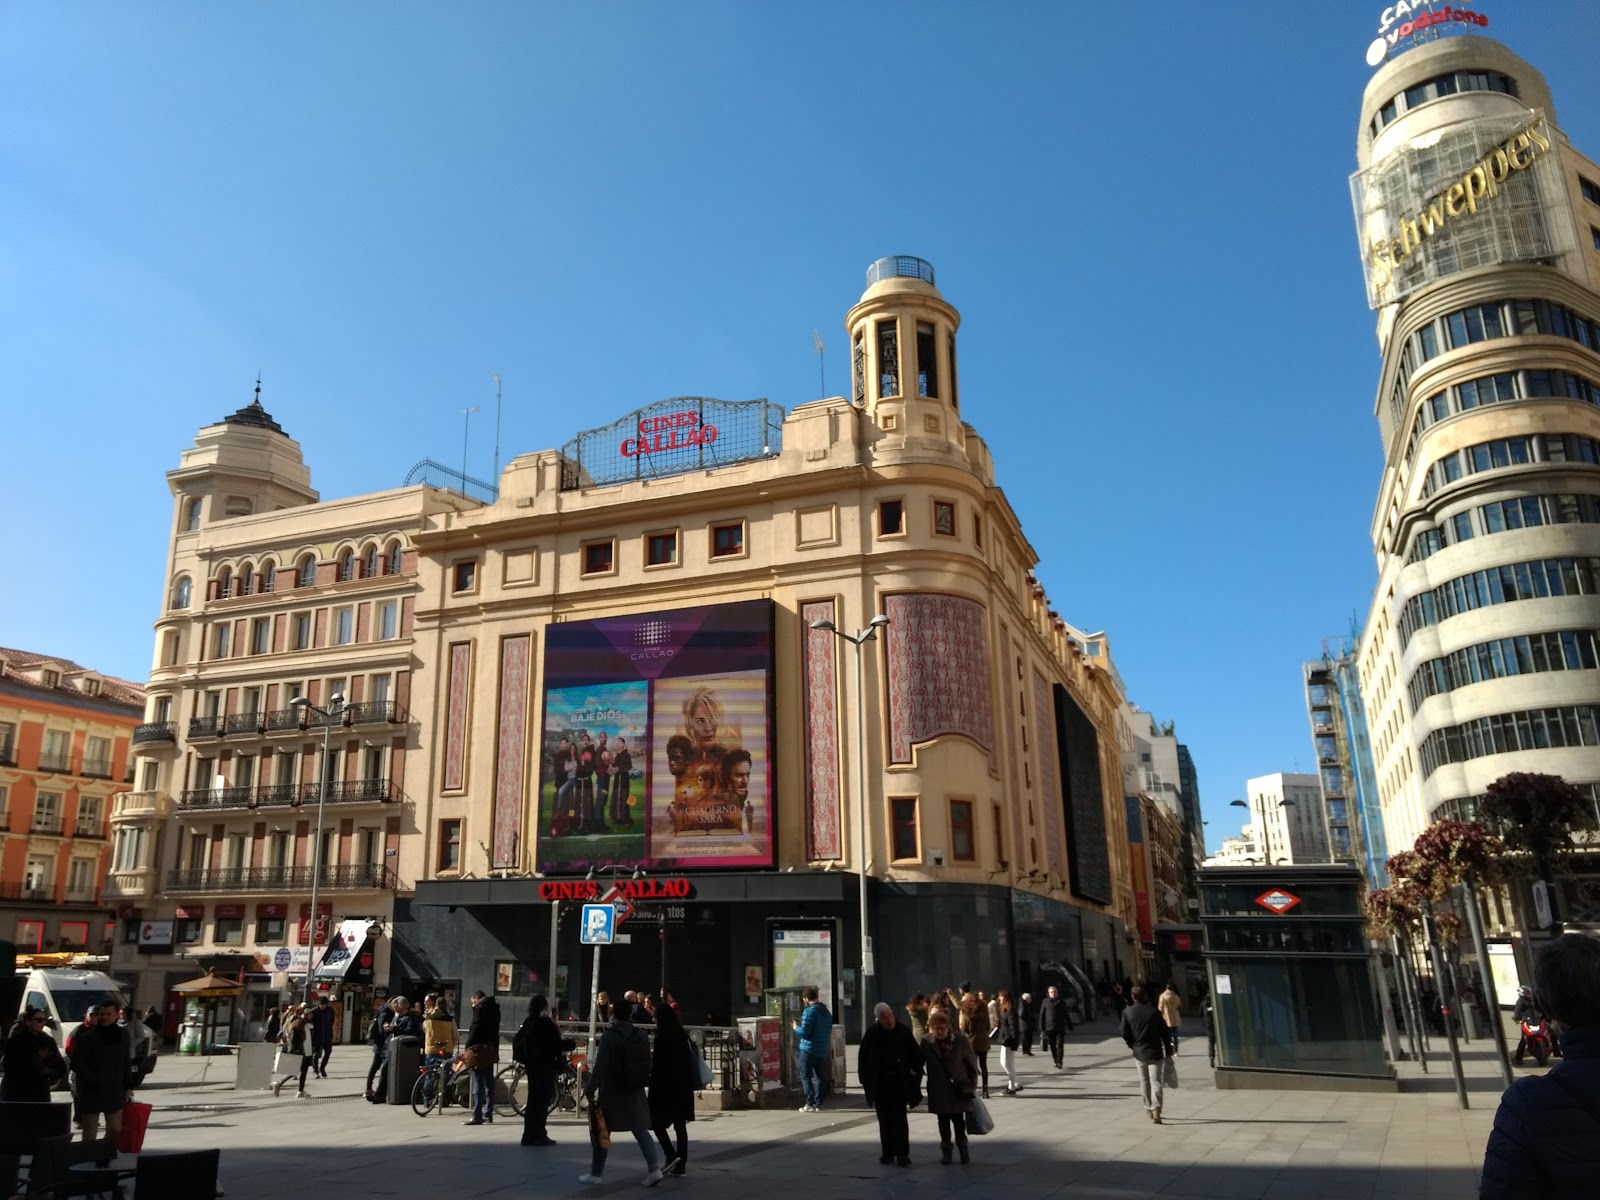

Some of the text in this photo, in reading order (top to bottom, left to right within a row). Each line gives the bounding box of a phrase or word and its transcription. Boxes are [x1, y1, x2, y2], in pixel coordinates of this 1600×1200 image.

[1386, 5, 1489, 44] vodafone
[1371, 117, 1550, 290] Schweppes
[638, 410, 699, 434] CINES
[620, 424, 718, 457] CALLAO
[630, 650, 674, 660] CALLAO
[570, 709, 622, 723] BAJE DIOS
[685, 804, 737, 815] CUADERNO
[700, 814, 723, 824] SARA
[538, 881, 598, 899] CINES
[1265, 896, 1290, 905] Metro
[330, 949, 349, 958] HOT
